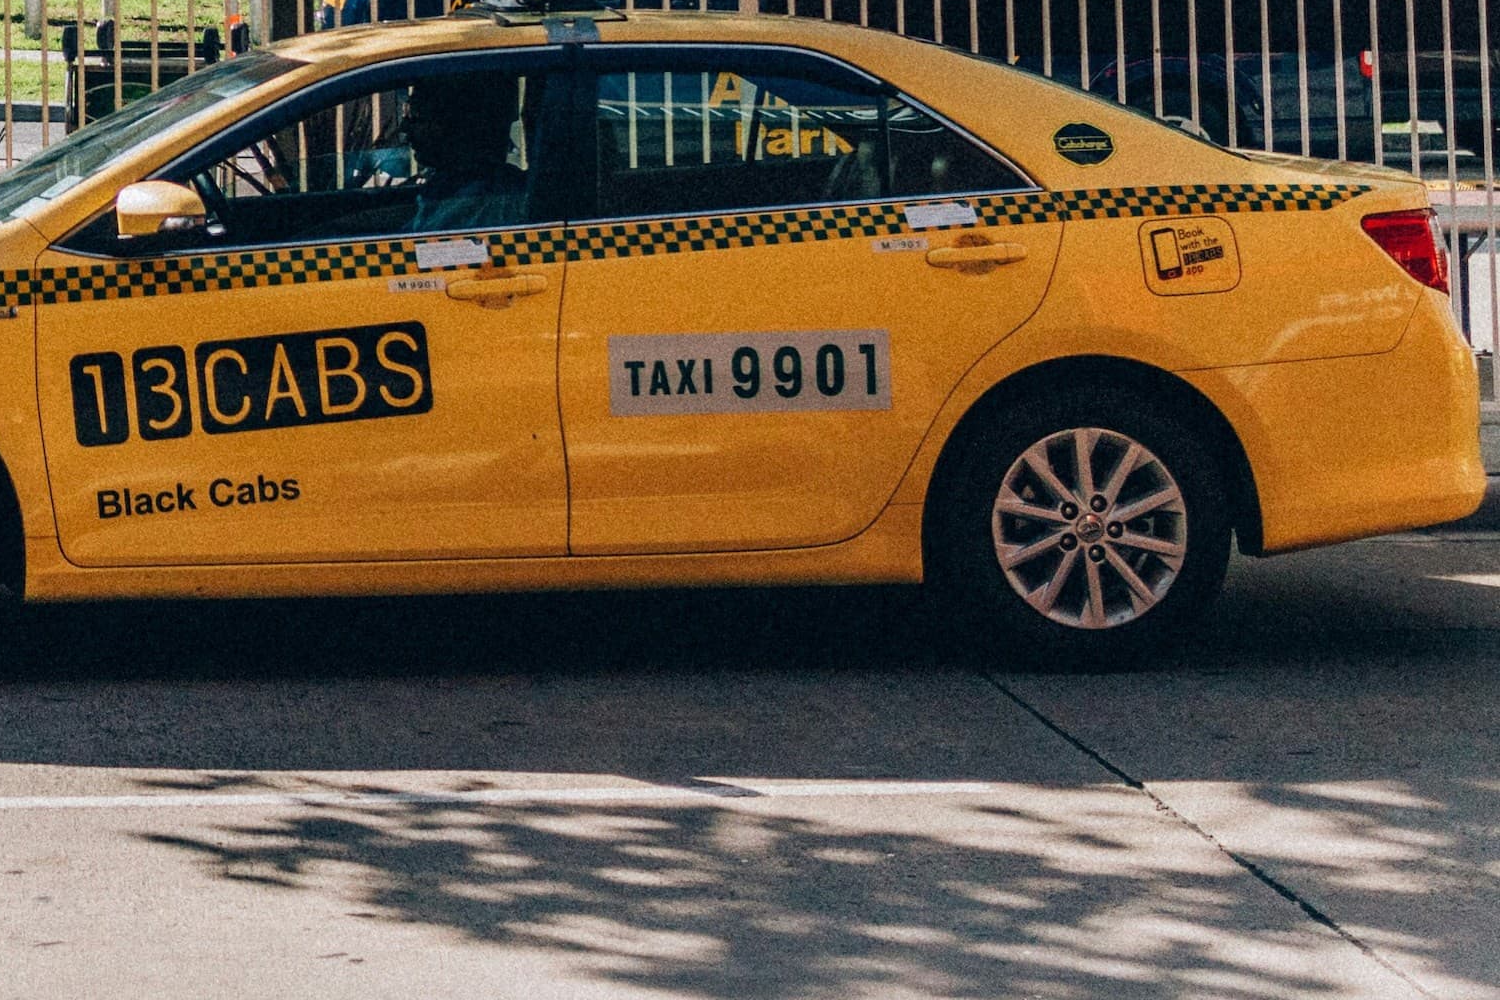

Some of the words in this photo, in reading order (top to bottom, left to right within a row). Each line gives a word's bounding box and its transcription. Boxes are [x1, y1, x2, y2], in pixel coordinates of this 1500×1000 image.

[1178, 226, 1204, 240] Book
[1180, 239, 1200, 250] with
[1203, 236, 1218, 247] the
[80, 328, 427, 436] 13CABS
[623, 358, 713, 397] TAXI
[731, 343, 877, 399] 9901
[97, 483, 197, 519] Black
[208, 475, 301, 508] Cabs
